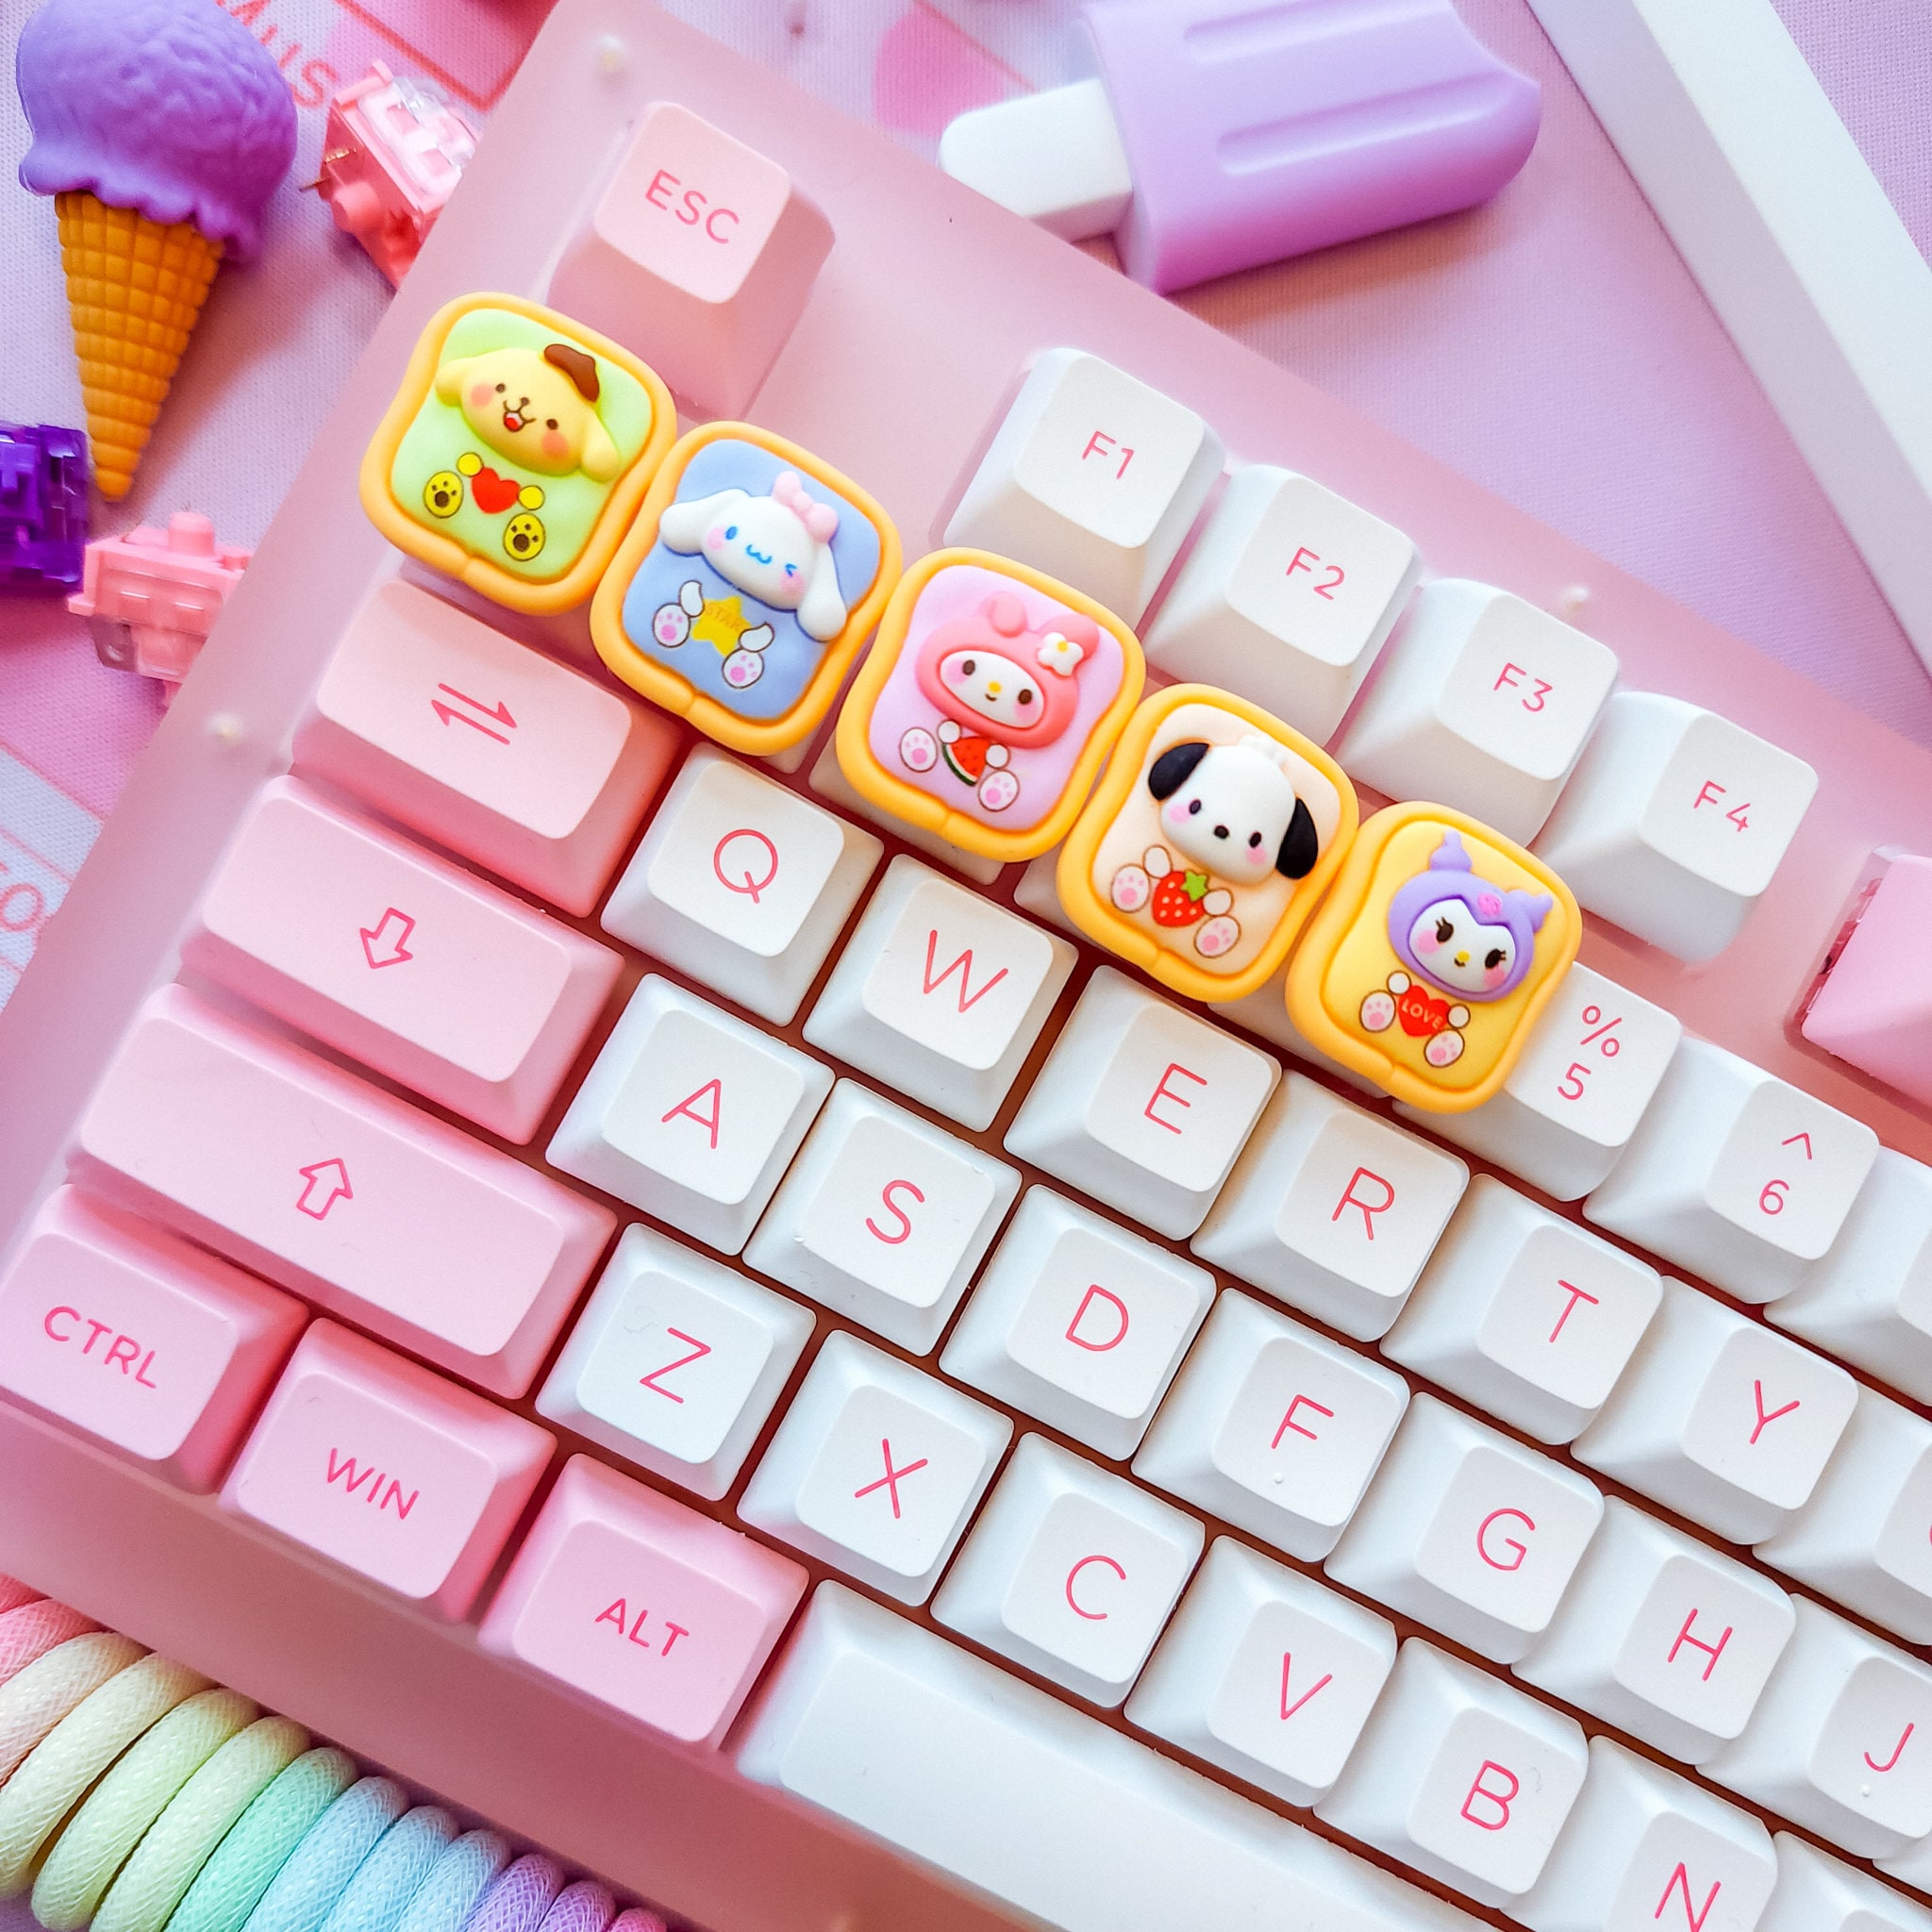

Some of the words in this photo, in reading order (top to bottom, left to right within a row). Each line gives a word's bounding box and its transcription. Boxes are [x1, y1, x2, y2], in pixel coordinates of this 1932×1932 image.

[644, 169, 740, 244] ESC
[1081, 430, 1135, 480] F1
[1285, 546, 1345, 601] F2
[1493, 661, 1554, 713] F3
[1692, 780, 1751, 833] F4
[712, 827, 779, 905] Q
[922, 928, 1009, 1014] W
[1401, 998, 1443, 1030] LOVE
[1579, 1005, 1623, 1058] %
[660, 1077, 723, 1150] A
[1143, 1061, 1208, 1136] E
[1557, 1062, 1591, 1101] 5
[864, 1179, 925, 1245] S
[1331, 1166, 1396, 1241] R
[1758, 1178, 1790, 1216] 6
[1064, 1283, 1130, 1353] D
[1548, 1279, 1600, 1344] T
[43, 1306, 156, 1390] CTRL
[638, 1326, 712, 1405] Z
[1270, 1393, 1335, 1450] F
[1748, 1379, 1801, 1446] Y
[325, 1448, 420, 1521] WIN
[853, 1438, 929, 1521] X
[1476, 1507, 1537, 1573] G
[1065, 1554, 1127, 1621] C
[594, 1597, 690, 1657] ALT
[1666, 1607, 1734, 1682] H
[1279, 1651, 1333, 1722] V
[1863, 1722, 1916, 1774] J
[1459, 1759, 1521, 1832] B
[1653, 1861, 1722, 1932] N
